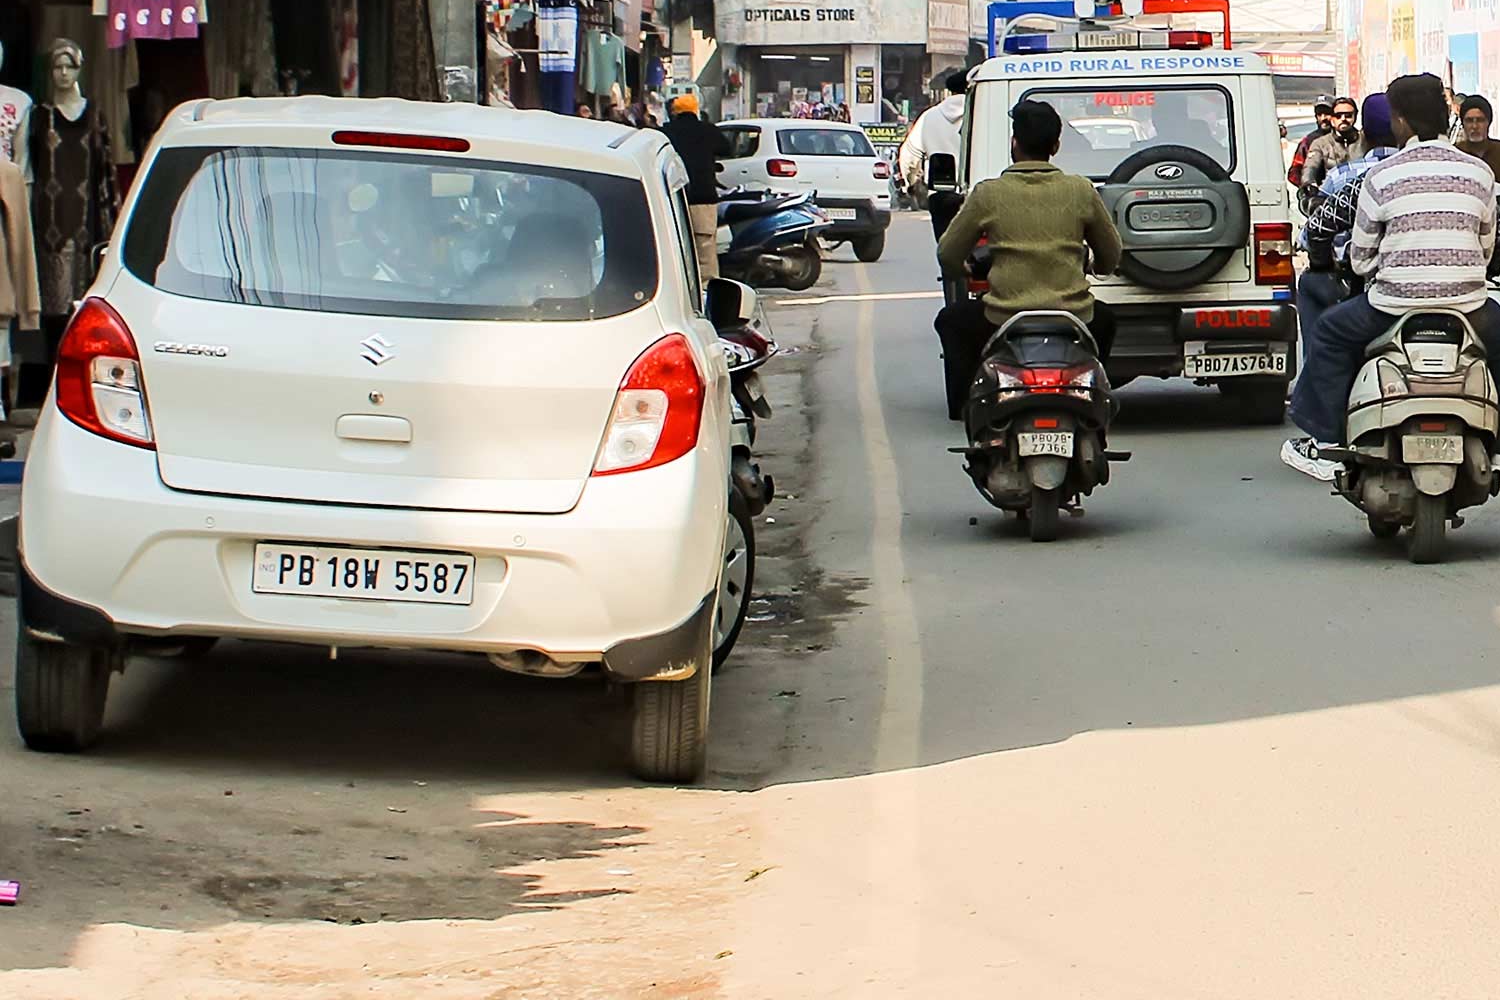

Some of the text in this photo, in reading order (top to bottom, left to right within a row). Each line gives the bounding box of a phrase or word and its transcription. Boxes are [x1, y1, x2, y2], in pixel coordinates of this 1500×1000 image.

[744, 9, 855, 22] OPTICALS STORE
[1004, 56, 1245, 74] RAPID RURAL RESPONSE
[1094, 92, 1155, 107] POLICE
[1195, 309, 1272, 329] POLICE
[1195, 356, 1285, 374] PB07AS7648
[278, 553, 315, 586] PB
[394, 560, 469, 595] 5587
